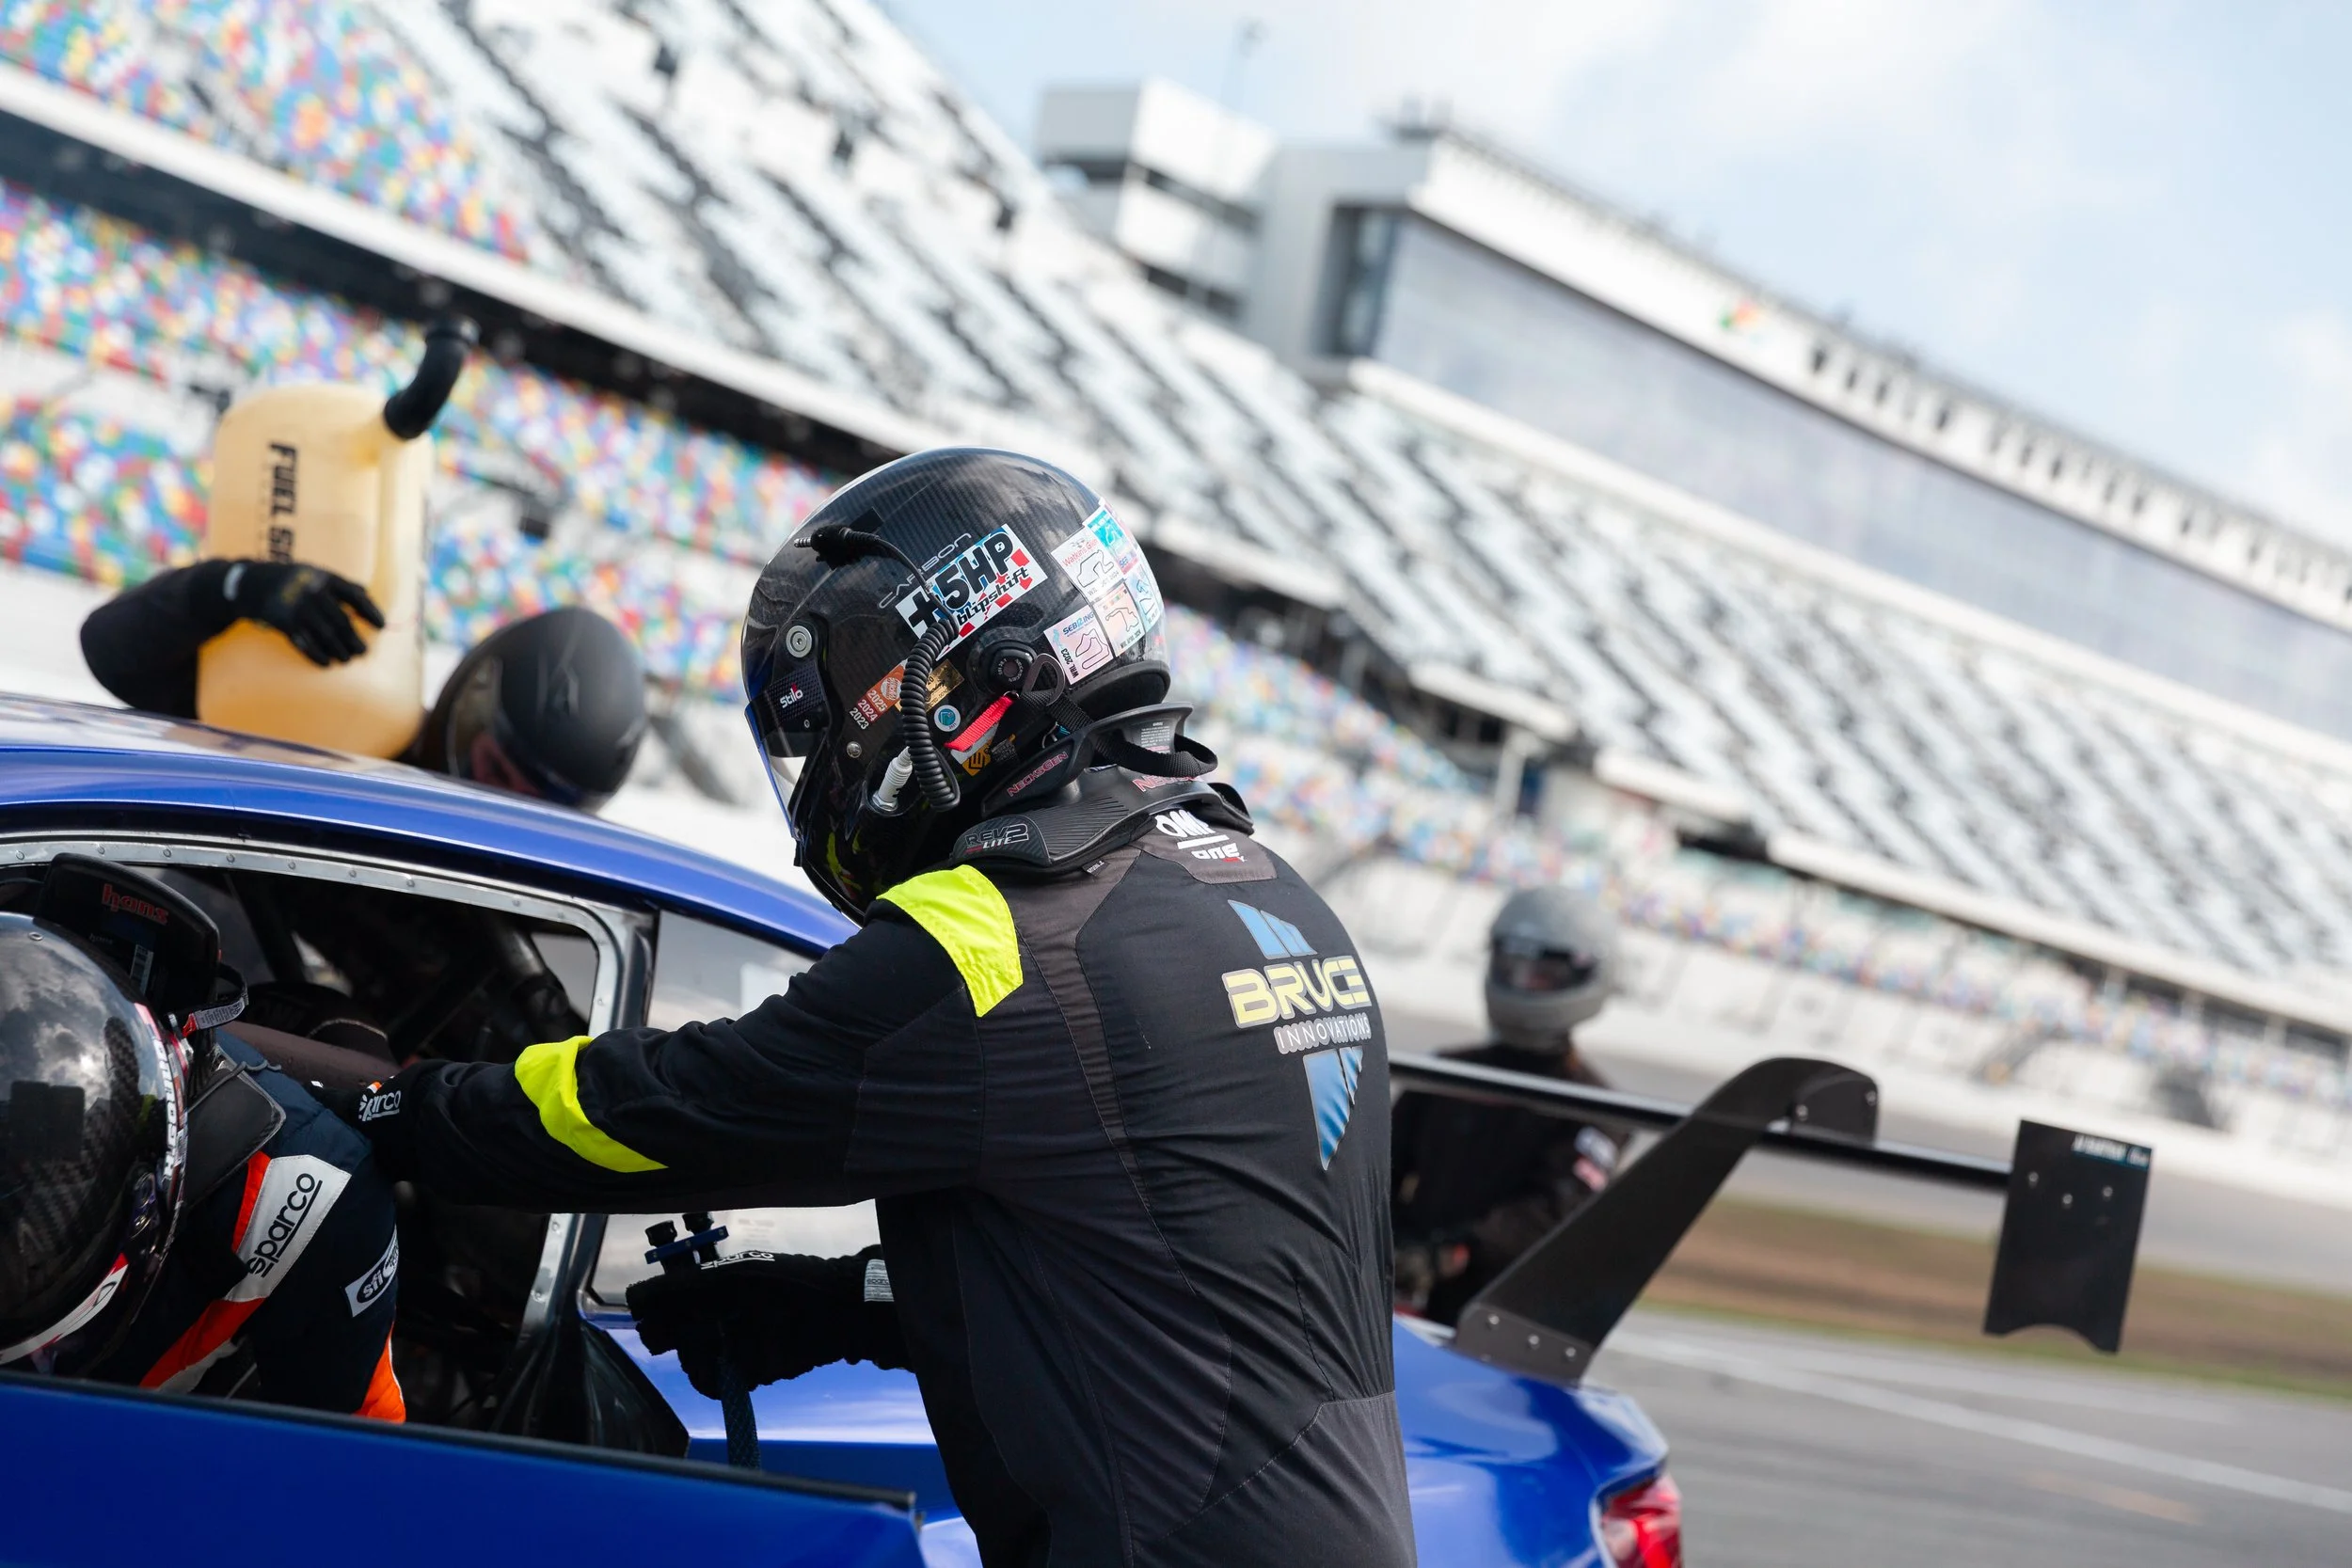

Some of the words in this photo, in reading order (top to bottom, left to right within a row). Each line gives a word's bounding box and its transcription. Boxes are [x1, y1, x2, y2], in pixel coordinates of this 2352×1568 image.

[269, 442, 296, 516] FUEL
[957, 566, 1029, 626] blipshift
[1060, 648, 1073, 665] 2023
[1069, 665, 1079, 678] WRL
[857, 699, 879, 721] 2024
[866, 689, 888, 712] 2025
[849, 707, 869, 730] 2023
[1007, 752, 1069, 797] NECKSGEN
[983, 836, 1013, 849] LITE
[102, 883, 169, 926] hans
[1222, 955, 1372, 1028] BRUCE
[1275, 1013, 1371, 1053] INNOVATIONS
[358, 1090, 401, 1121] sparco
[246, 1172, 317, 1276] sparco
[700, 1251, 775, 1270] sparco
[363, 1270, 383, 1298] sfi
